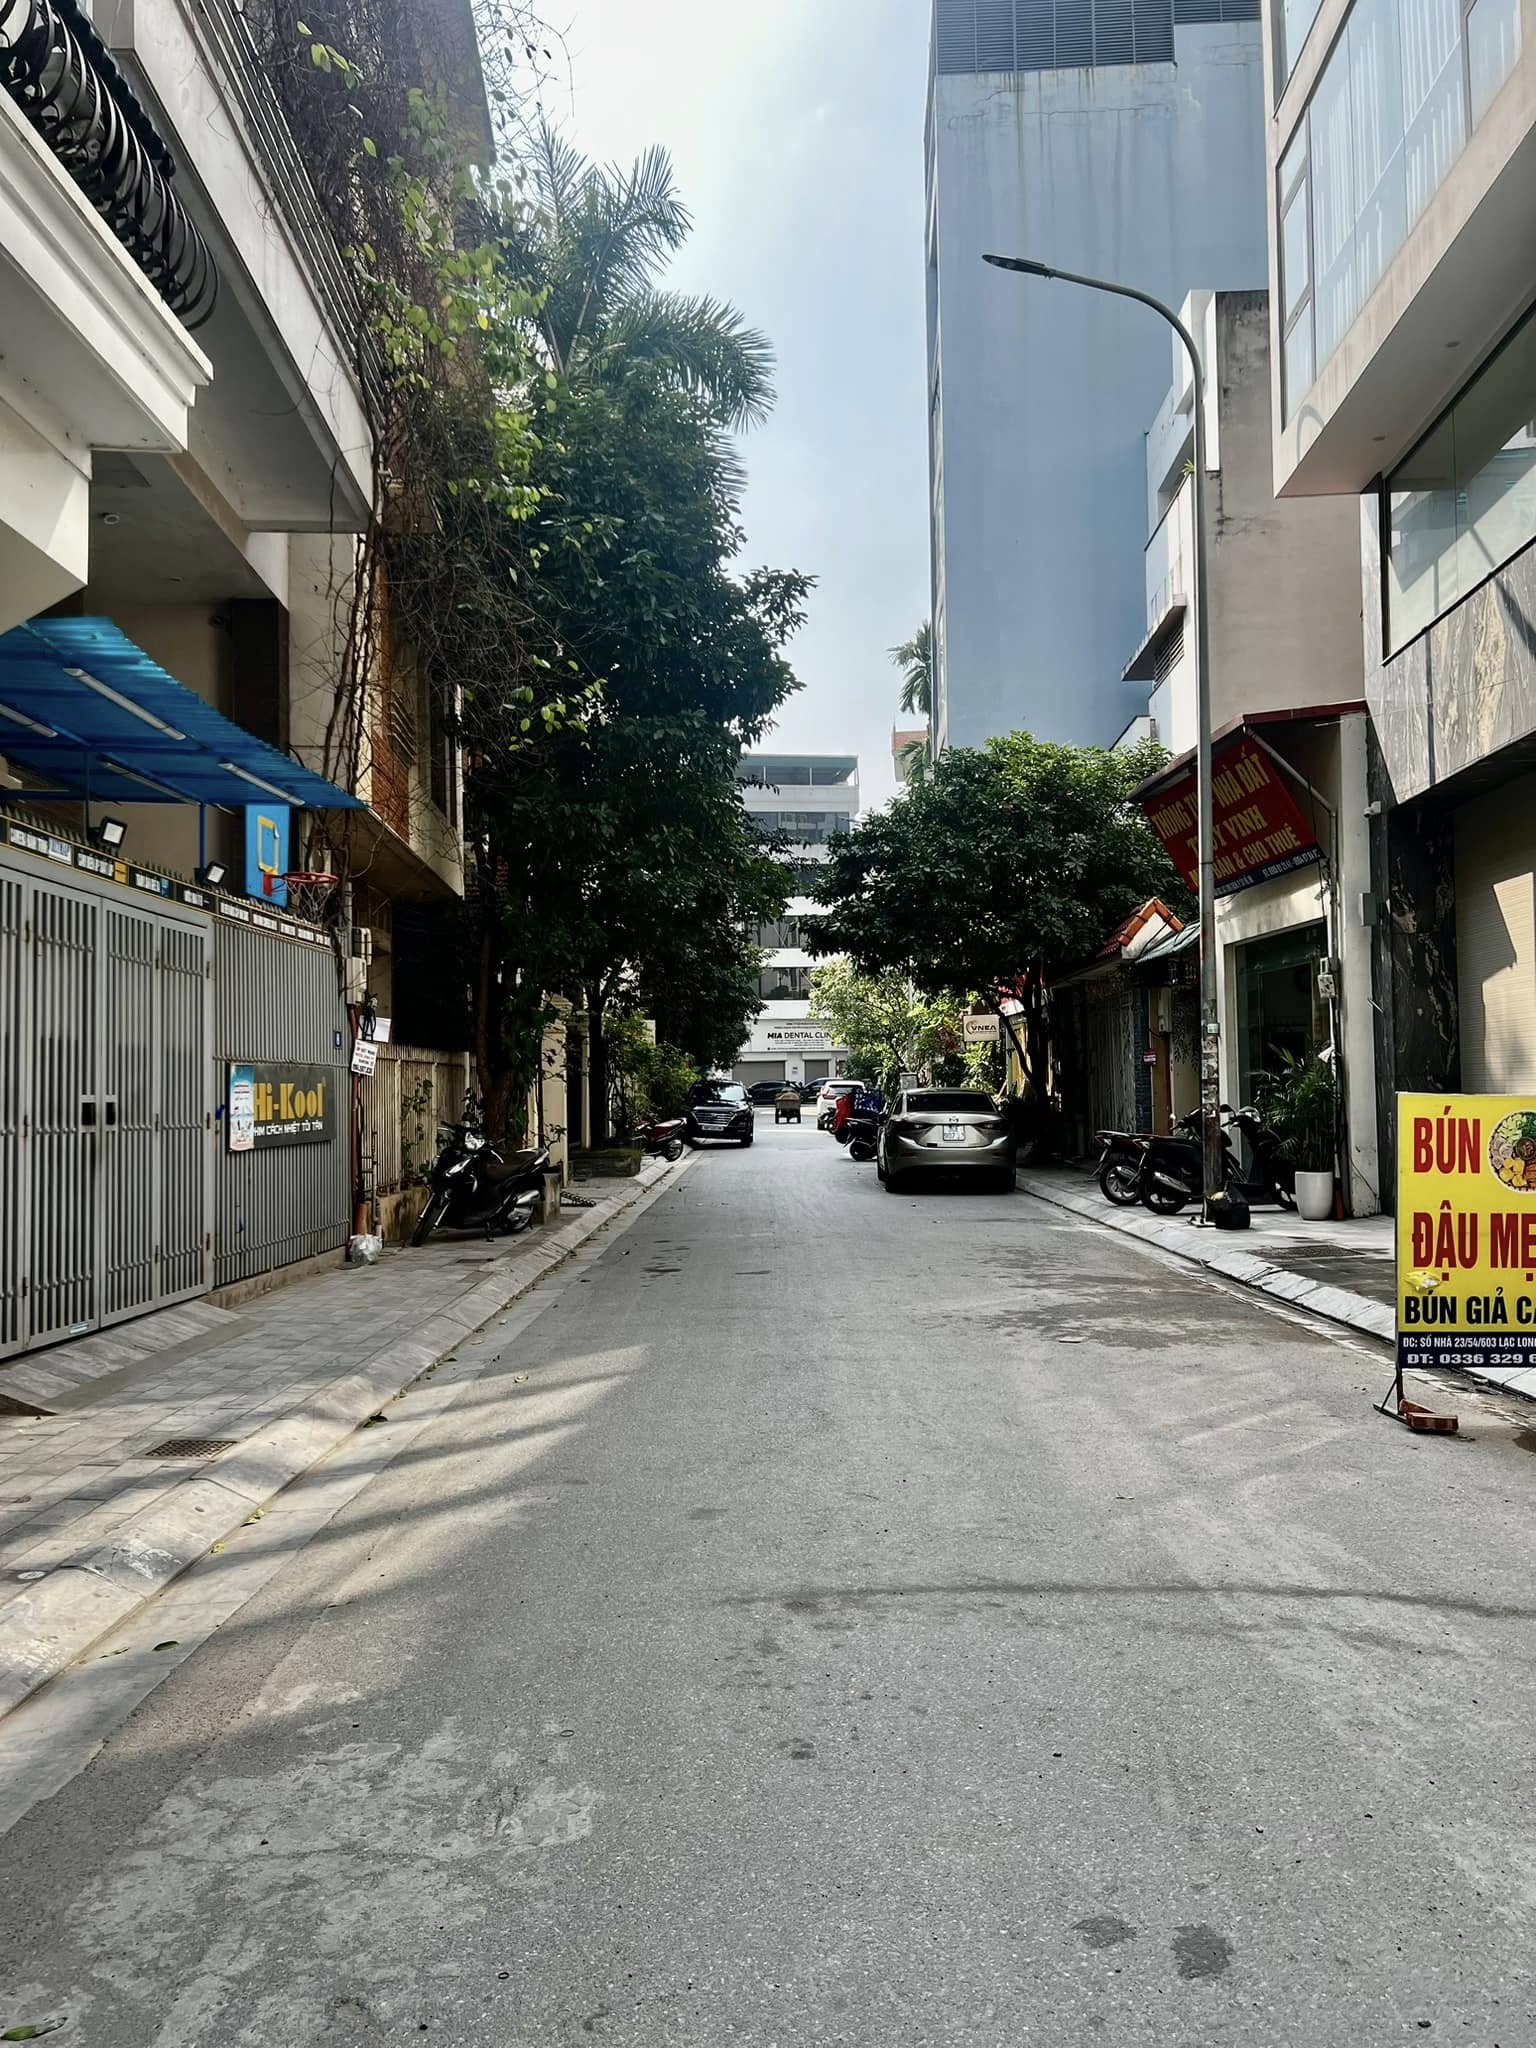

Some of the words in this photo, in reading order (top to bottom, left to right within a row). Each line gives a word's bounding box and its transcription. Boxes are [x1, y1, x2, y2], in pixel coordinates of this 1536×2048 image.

[1212, 764, 1246, 808] NHÀ
[1234, 744, 1270, 794] ĐẤT
[1222, 804, 1268, 840] VINH
[1233, 851, 1247, 869] &
[1242, 838, 1270, 866] CHO
[1264, 822, 1302, 856] THUÊ
[254, 1082, 323, 1121] Hi-Kool
[254, 1126, 265, 1136] HIM
[266, 1123, 283, 1135] CÁCH
[284, 1121, 300, 1135] NHIỆT
[1412, 1105, 1480, 1174] BÚN
[1411, 1199, 1478, 1281] ĐẬU
[1405, 1289, 1457, 1324] BÚN
[1466, 1286, 1509, 1324] GIẢ
[1516, 1296, 1536, 1324] C
[1407, 1353, 1434, 1364] ĐT:
[1439, 1353, 1484, 1364] 0336
[1489, 1353, 1523, 1364] 329
[1420, 1334, 1432, 1347] SỐ
[1434, 1336, 1452, 1347] NHÀ
[1499, 1337, 1515, 1350] LẠC
